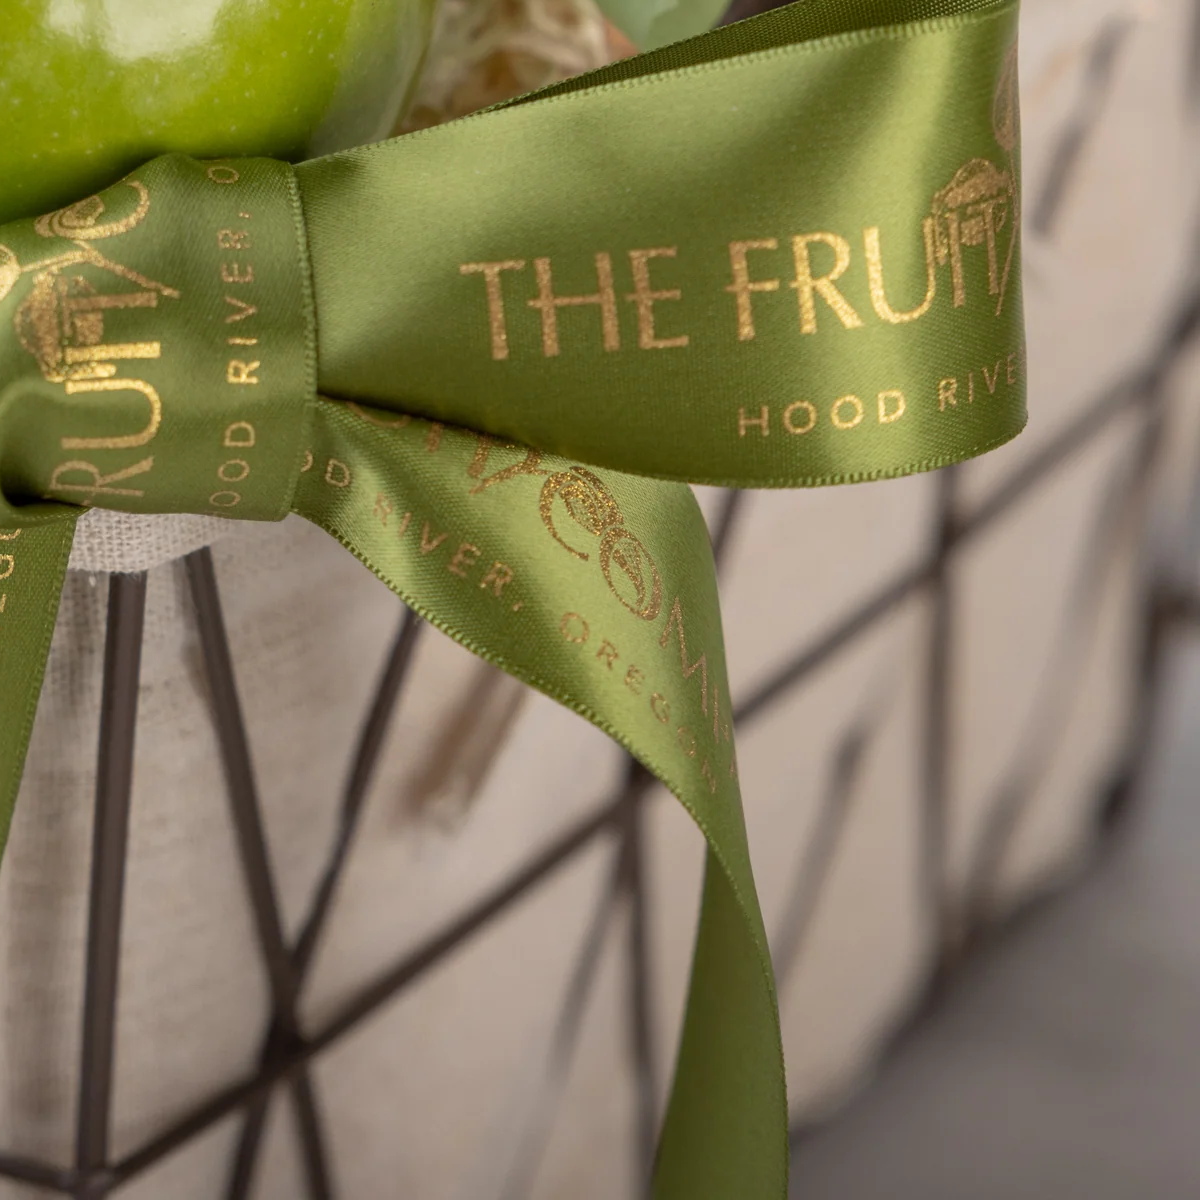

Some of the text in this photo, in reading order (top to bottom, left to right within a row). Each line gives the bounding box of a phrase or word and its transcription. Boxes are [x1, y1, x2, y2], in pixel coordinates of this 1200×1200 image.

[216, 211, 261, 385] RIVER,
[459, 197, 1008, 360] THE FRUIT
[209, 420, 256, 512] OOD
[738, 351, 1026, 437] HOOD RIVE
[372, 494, 718, 794] RIVER, OREGON
